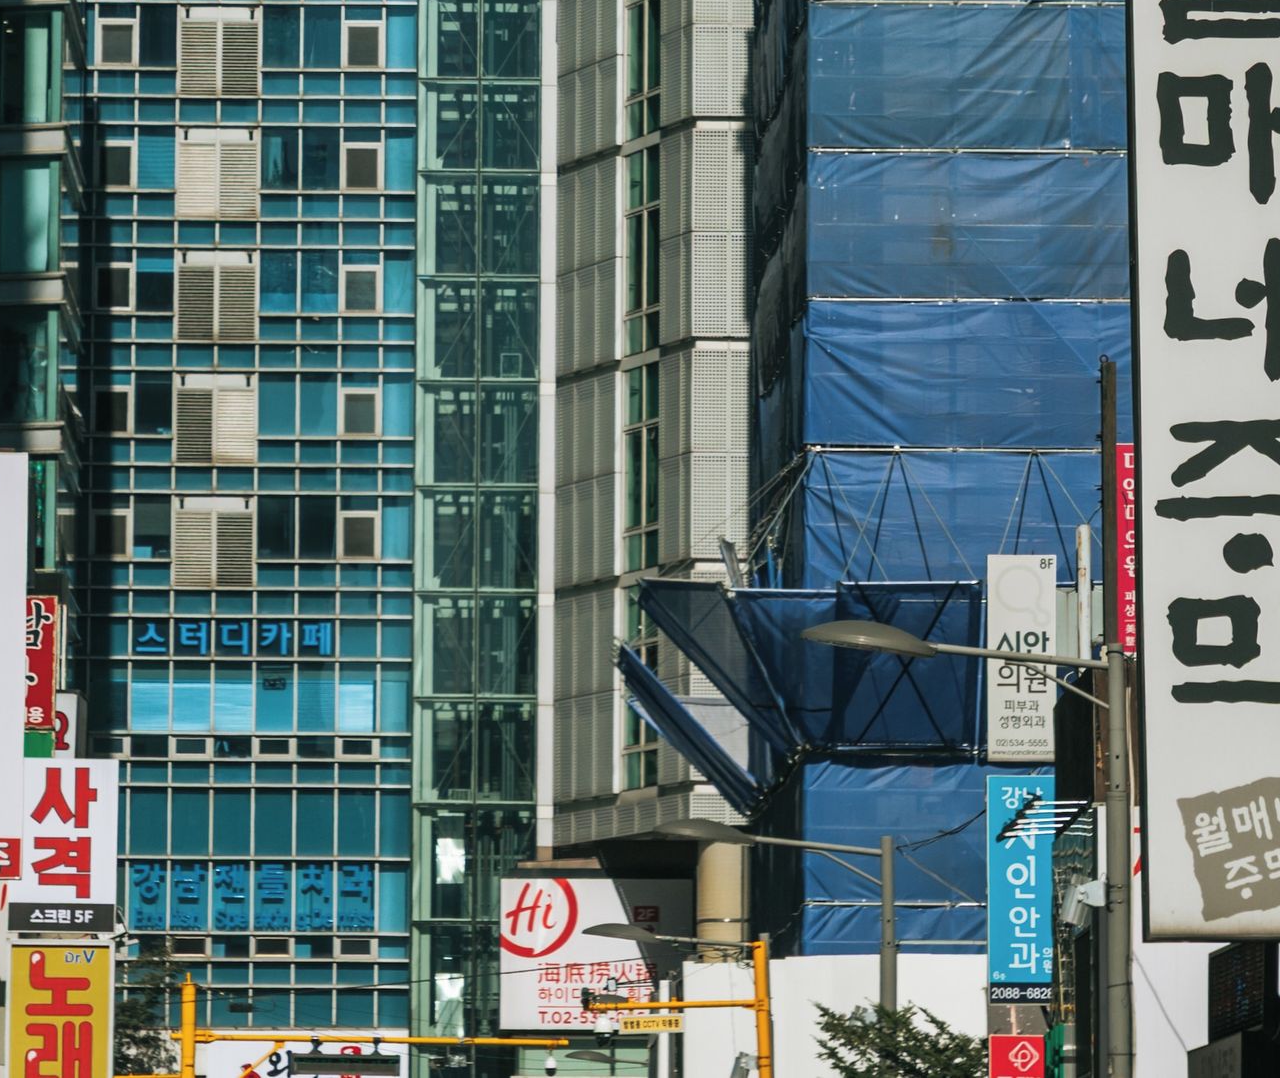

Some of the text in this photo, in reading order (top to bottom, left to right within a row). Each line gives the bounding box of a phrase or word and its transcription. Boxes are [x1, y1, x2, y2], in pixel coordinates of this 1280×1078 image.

[1039, 558, 1054, 570] 8F
[135, 622, 333, 657] 스터디카페
[997, 662, 1048, 693] 의원
[1004, 699, 1040, 713] 피부과
[999, 715, 1046, 729] 성형외과
[30, 766, 97, 899] 사격
[30, 909, 94, 923] 스크린 5F
[505, 882, 557, 936] Hi
[637, 908, 656, 919] 2F
